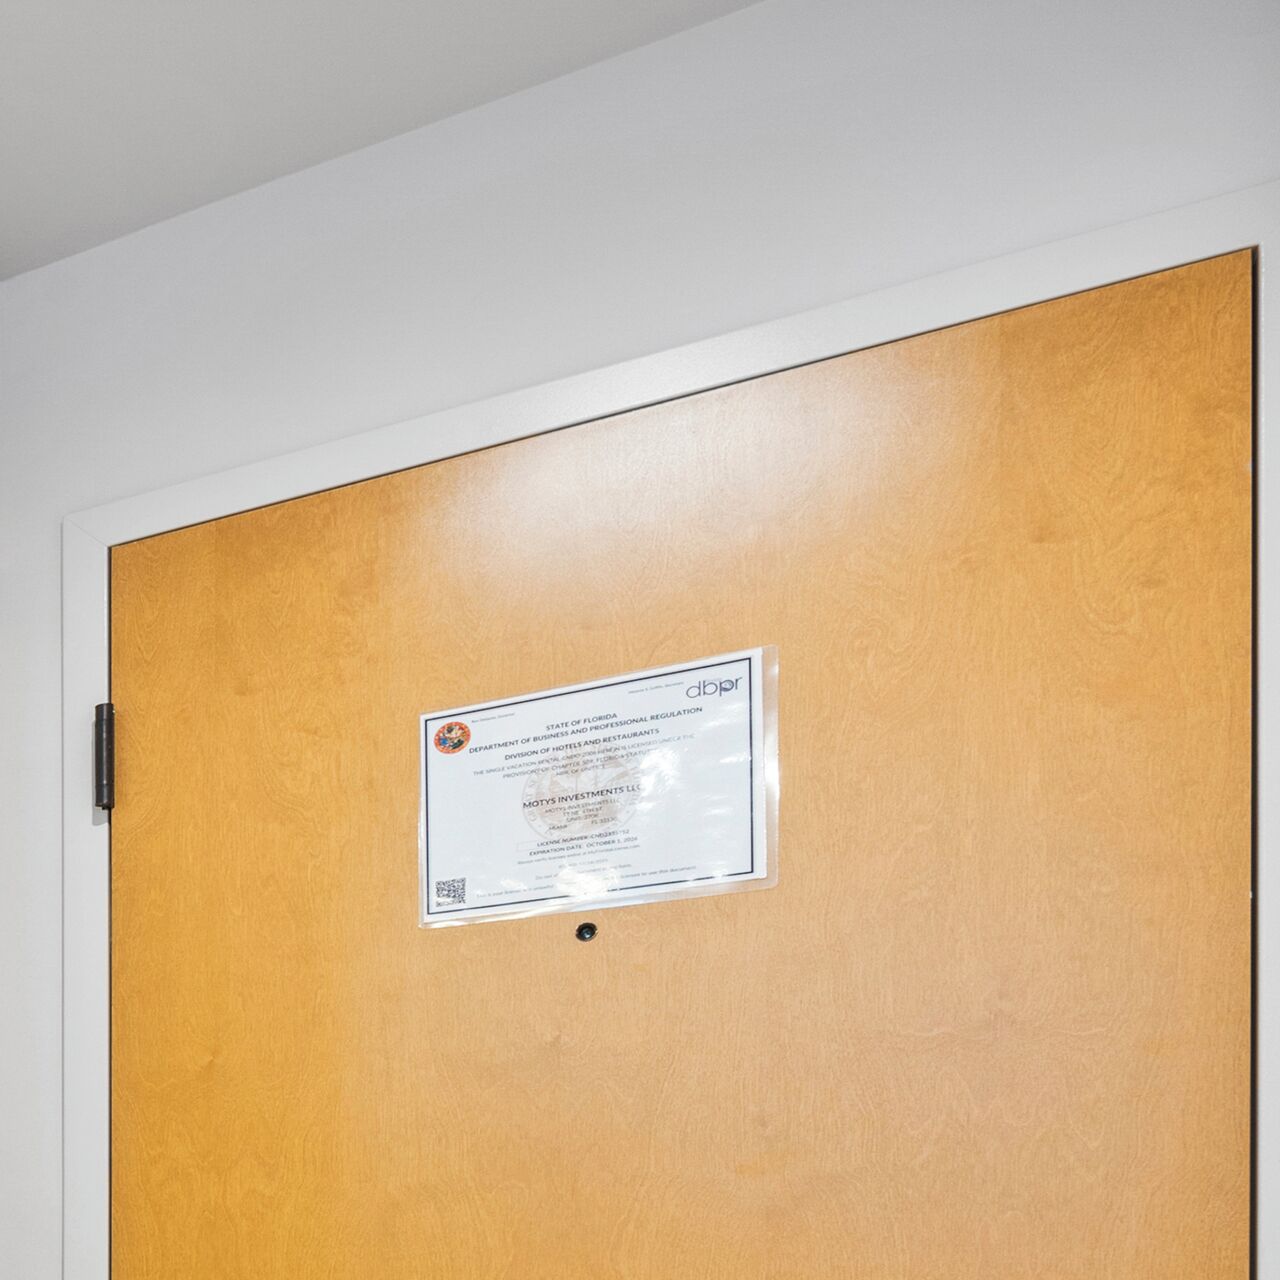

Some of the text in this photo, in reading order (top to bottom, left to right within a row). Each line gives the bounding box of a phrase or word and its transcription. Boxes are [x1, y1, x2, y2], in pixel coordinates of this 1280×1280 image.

[686, 677, 742, 698] dbpr
[469, 707, 703, 754] DEPARTMENT OF BUSINESS AND PROFESSIONAL REGULATION
[546, 713, 618, 731] STATE OF FLORIDA
[505, 728, 660, 760] DIVISION OF HOTELS AND RESTAURANTS
[523, 797, 556, 809] MOTYS
[558, 787, 624, 803] INVESTMENTS
[529, 845, 565, 856] EXPIRATION
[586, 839, 616, 848] OCTOBER
